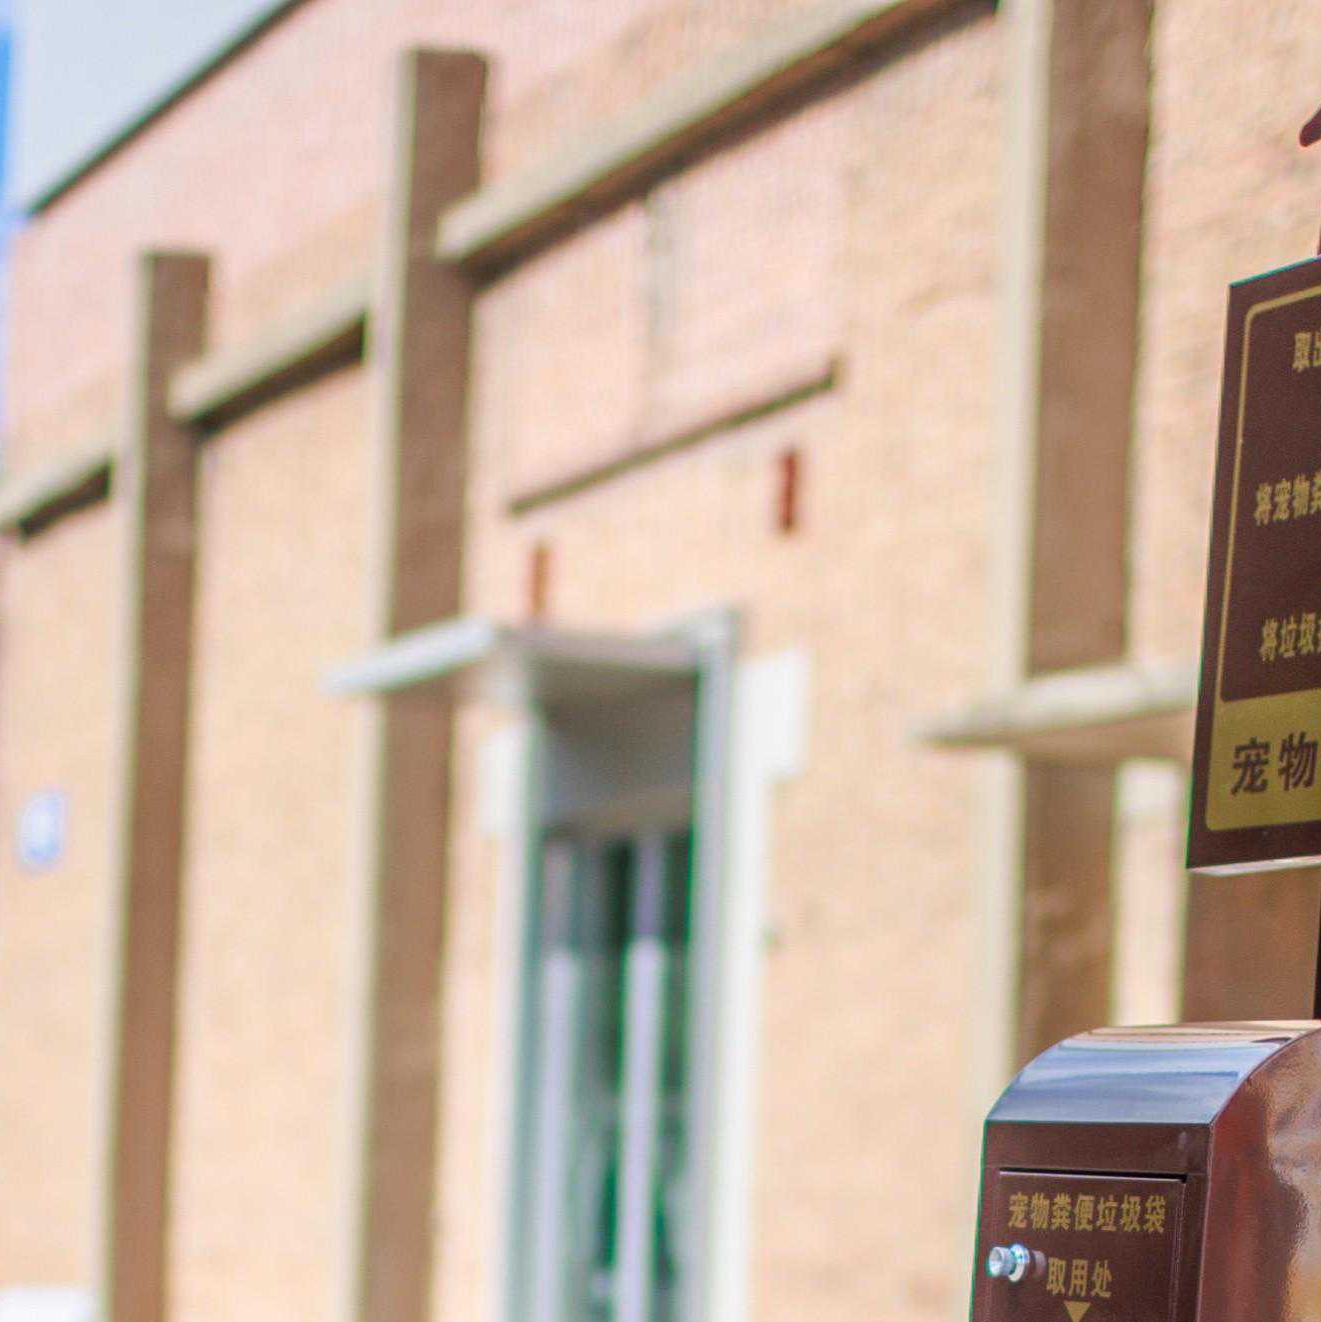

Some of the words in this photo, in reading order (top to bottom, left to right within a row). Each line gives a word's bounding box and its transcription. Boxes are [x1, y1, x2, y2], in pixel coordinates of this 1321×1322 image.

[1007, 1192, 1167, 1234] 宠物粪便垃圾袋
[1045, 1257, 1113, 1298] 取用处
